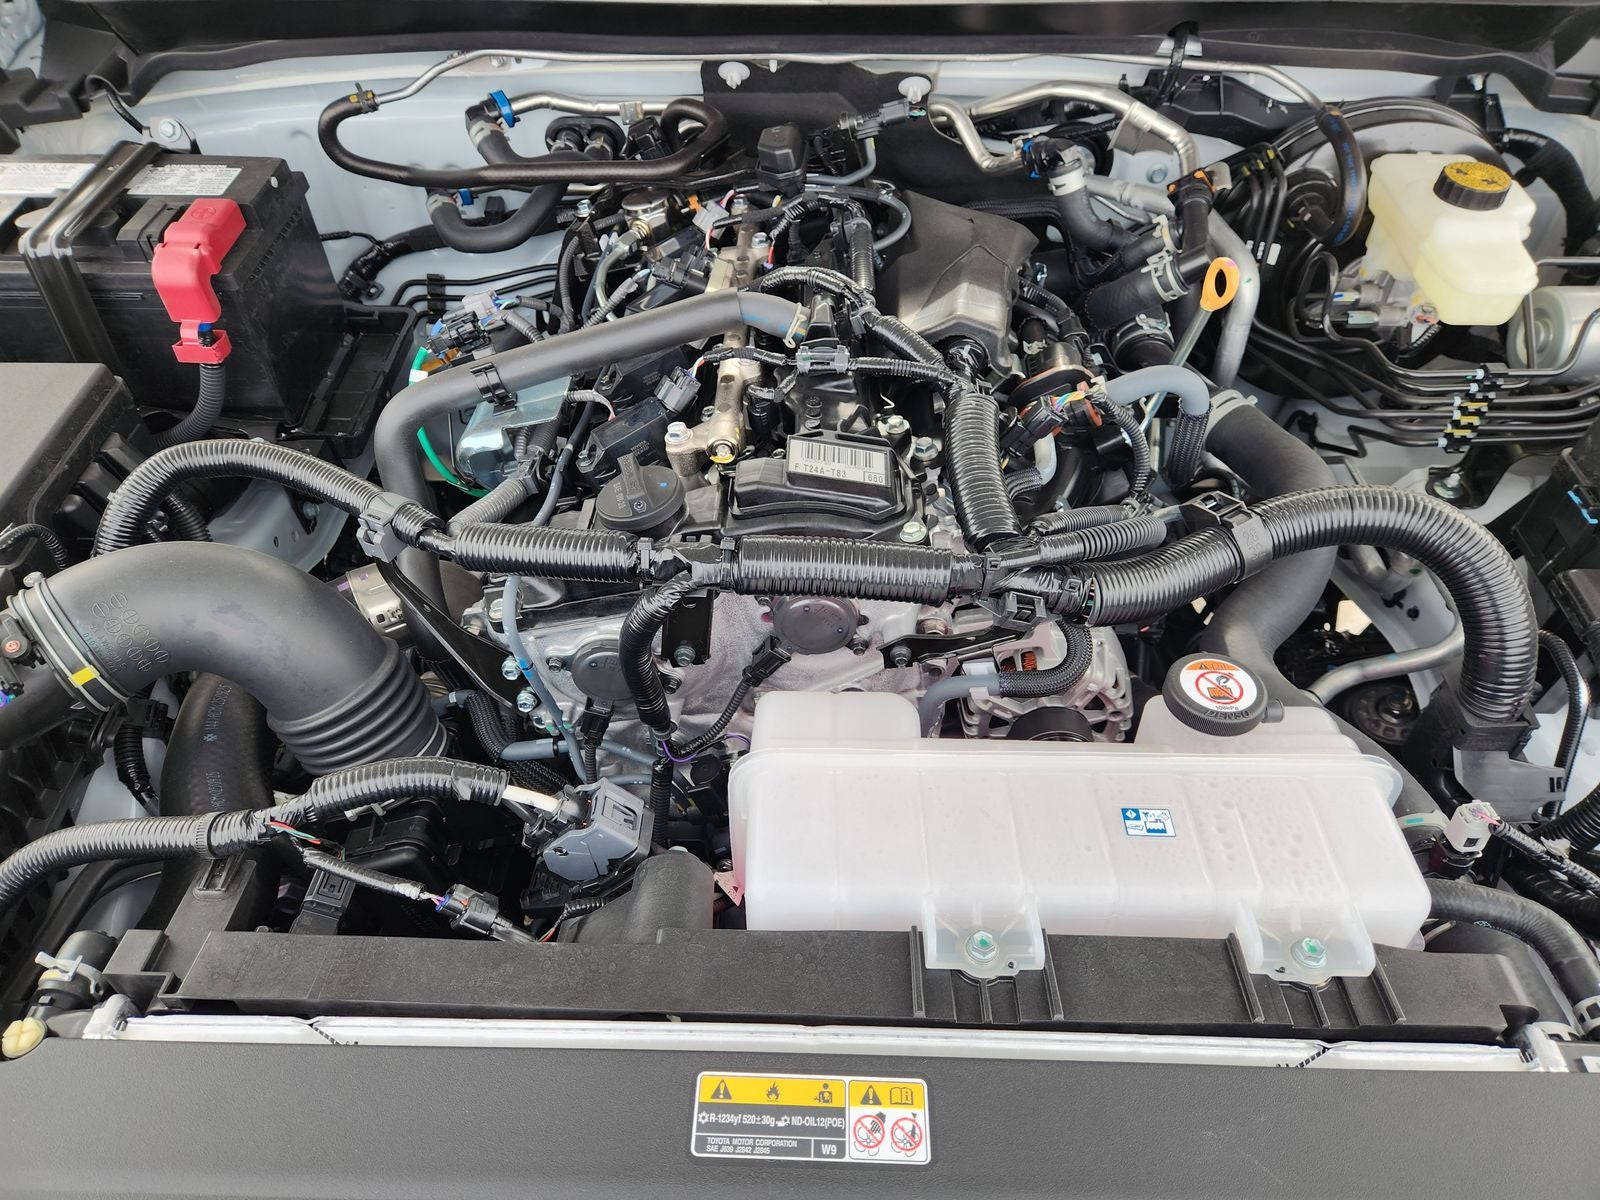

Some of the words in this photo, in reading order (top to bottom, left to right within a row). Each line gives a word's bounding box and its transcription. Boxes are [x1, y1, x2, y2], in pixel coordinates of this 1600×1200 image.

[803, 464, 847, 478] T24A-T83
[1203, 710, 1250, 720] DENSO
[709, 1113, 742, 1126] R-1234yf
[742, 1114, 775, 1127] 520±30g
[791, 1115, 845, 1129] ND-OIL12(POE)
[706, 1137, 731, 1145] TOYOTA
[732, 1137, 754, 1146] MOTOR
[755, 1138, 798, 1148] CORPORATION
[706, 1144, 719, 1153] SAE
[821, 1143, 837, 1155] W9
